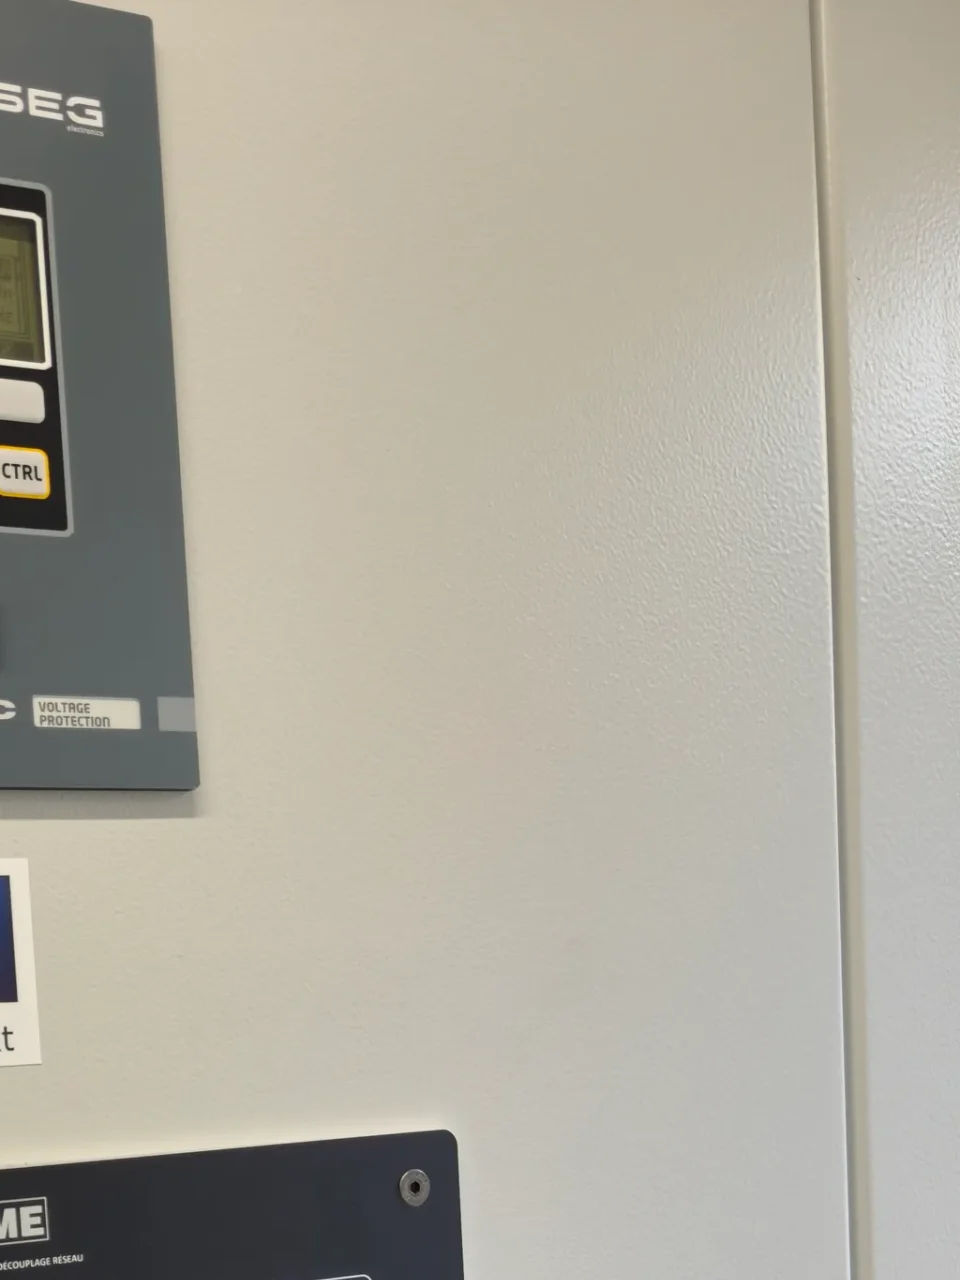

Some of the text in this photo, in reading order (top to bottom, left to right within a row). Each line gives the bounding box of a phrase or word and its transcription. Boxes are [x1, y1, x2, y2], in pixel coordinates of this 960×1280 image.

[66, 125, 104, 137] electronics
[1, 462, 43, 482] CTRL
[38, 701, 91, 714] VOLTAGE
[39, 715, 111, 728] PROTECTION
[52, 1253, 84, 1265] RÉSEAU
